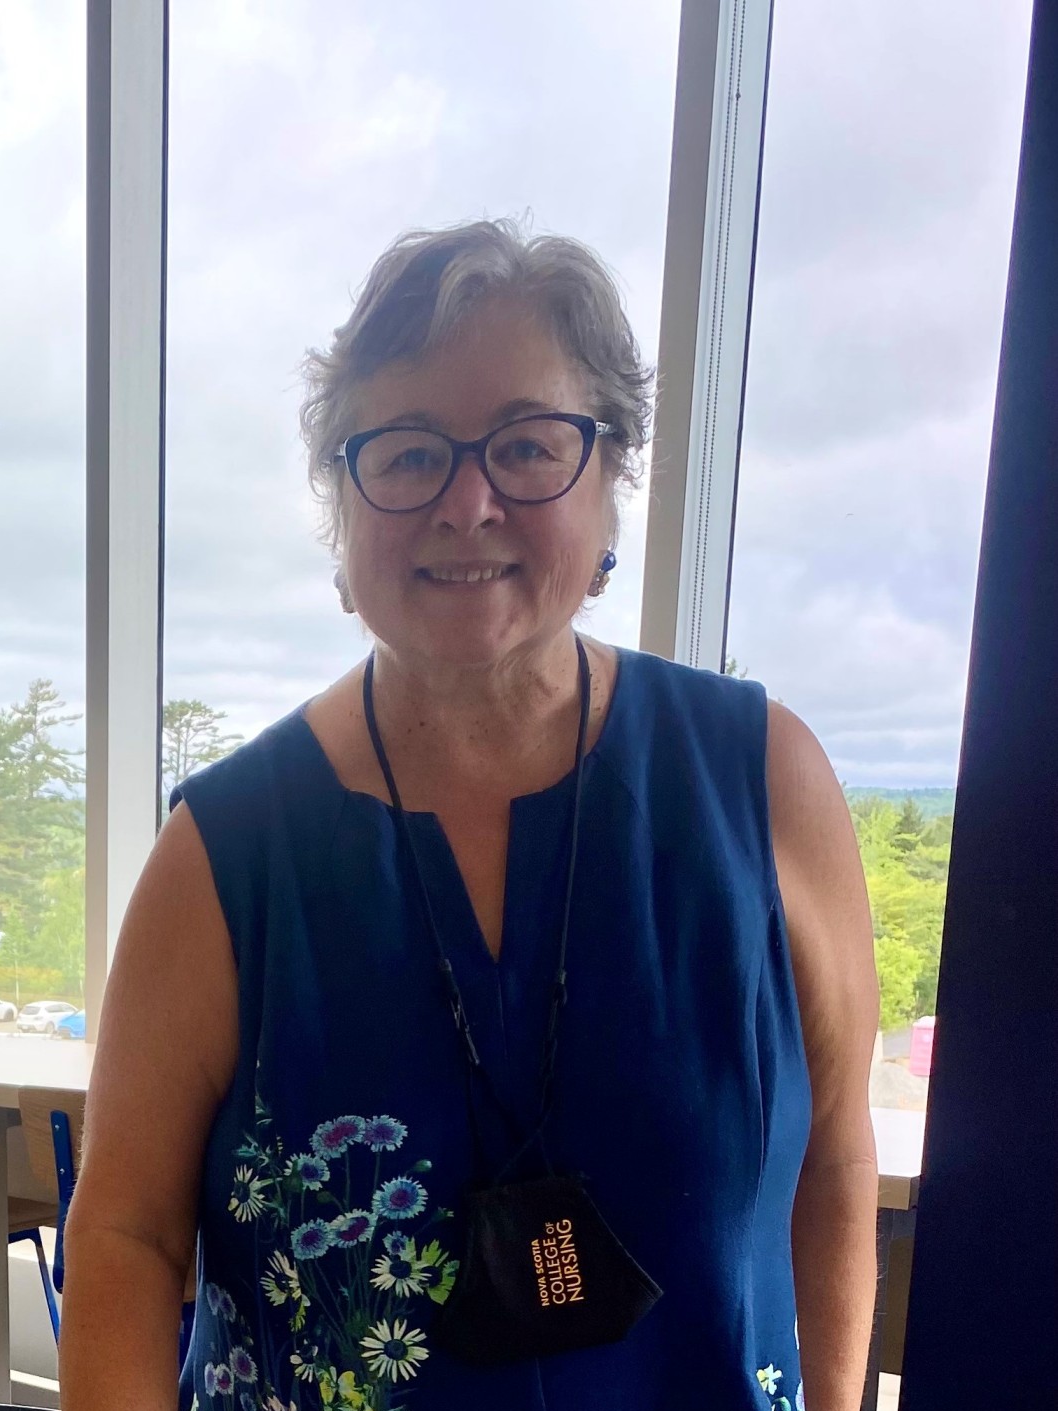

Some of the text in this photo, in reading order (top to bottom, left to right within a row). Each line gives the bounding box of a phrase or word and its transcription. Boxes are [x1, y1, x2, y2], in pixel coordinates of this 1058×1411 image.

[531, 1239, 550, 1306] NOVA SCOTIA
[543, 1222, 566, 1304] COLLEGE OF
[556, 1219, 584, 1301] NURSING
